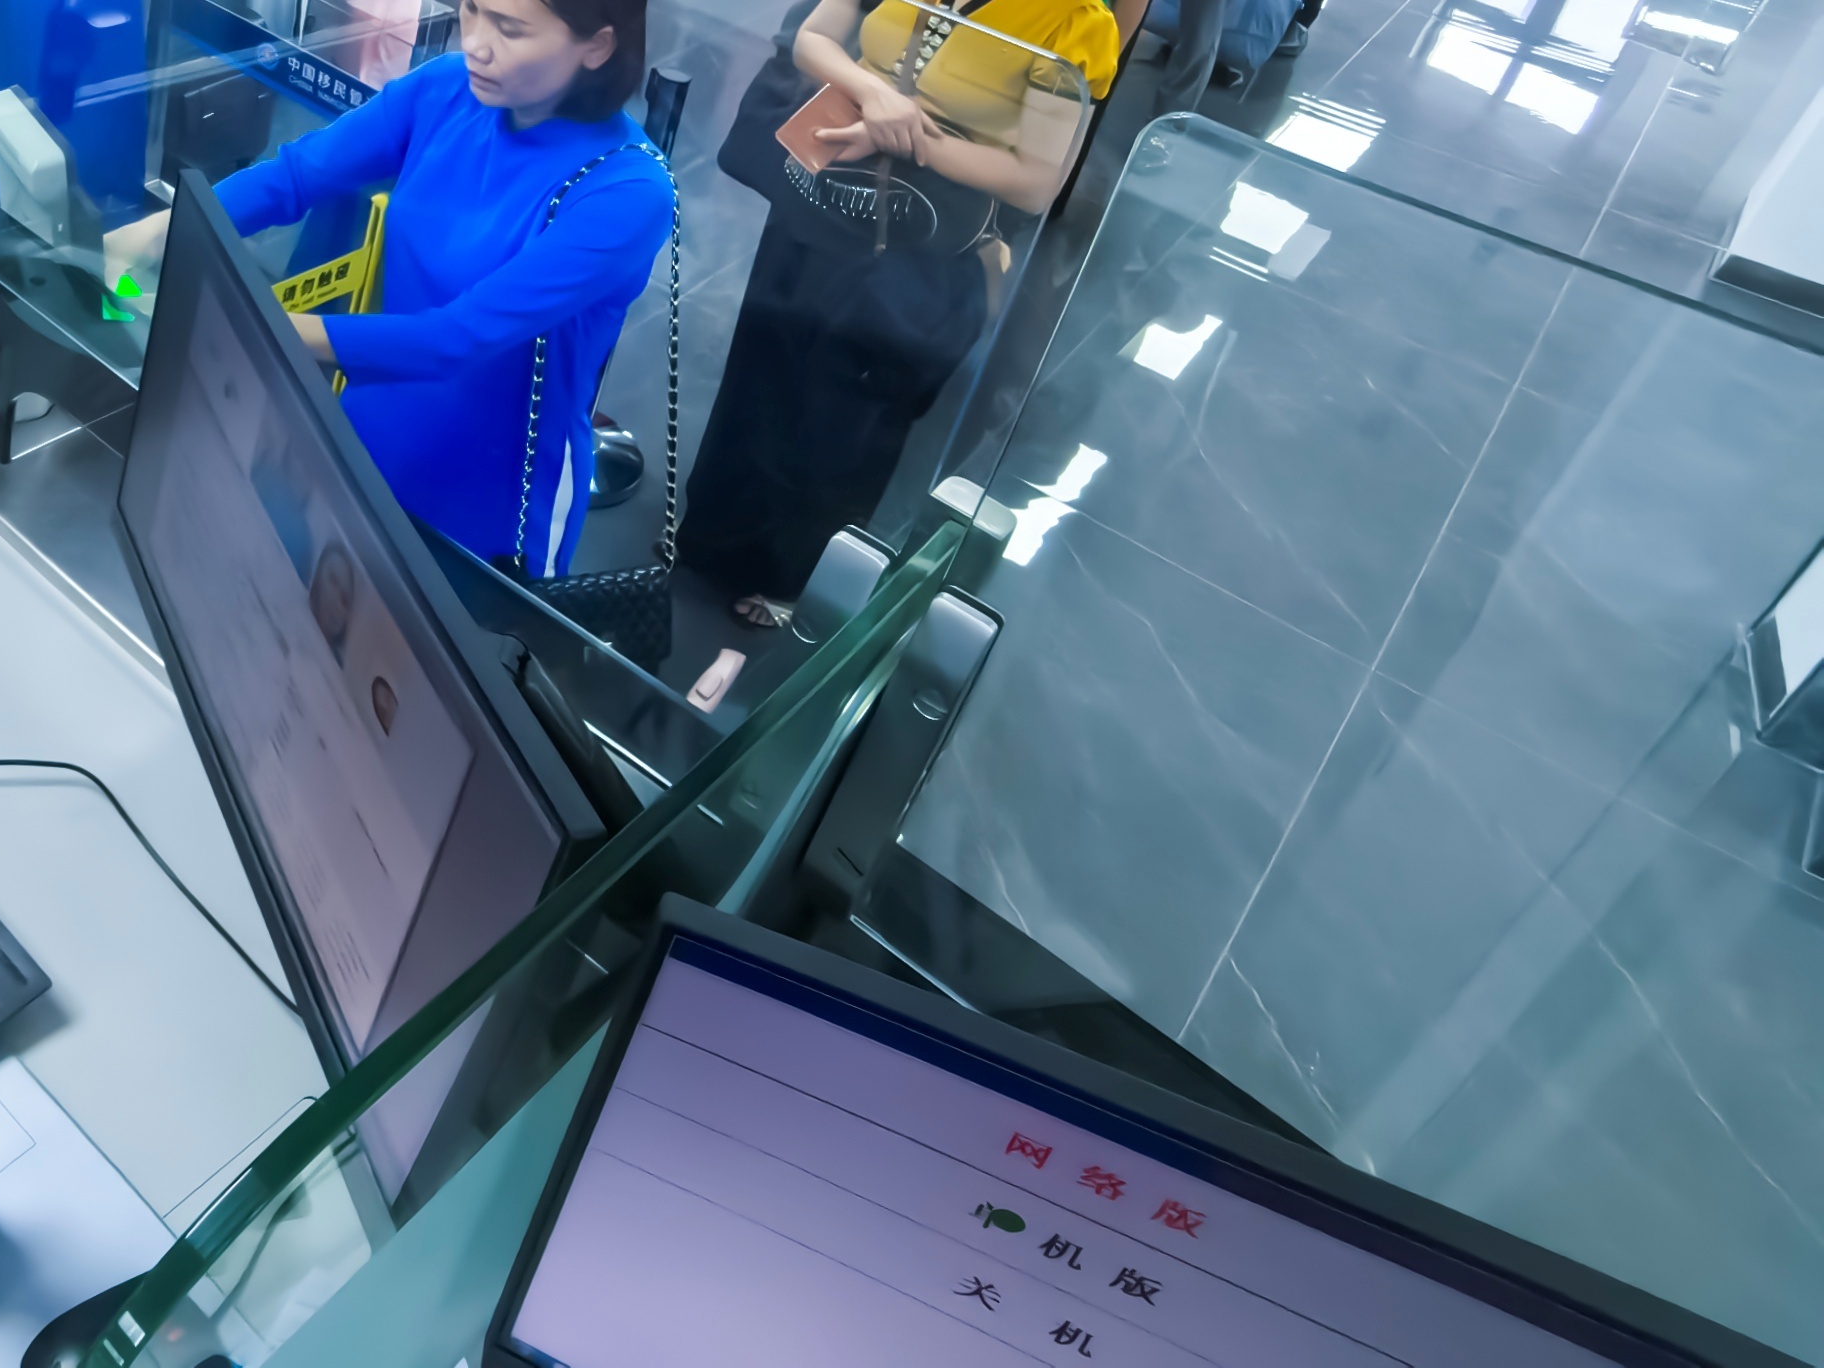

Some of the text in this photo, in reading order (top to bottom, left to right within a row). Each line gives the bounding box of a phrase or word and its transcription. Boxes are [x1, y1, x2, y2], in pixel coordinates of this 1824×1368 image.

[288, 56, 371, 107] 中国移民管
[1005, 1131, 1208, 1240] 网络版
[953, 1275, 1094, 1359] 关机
